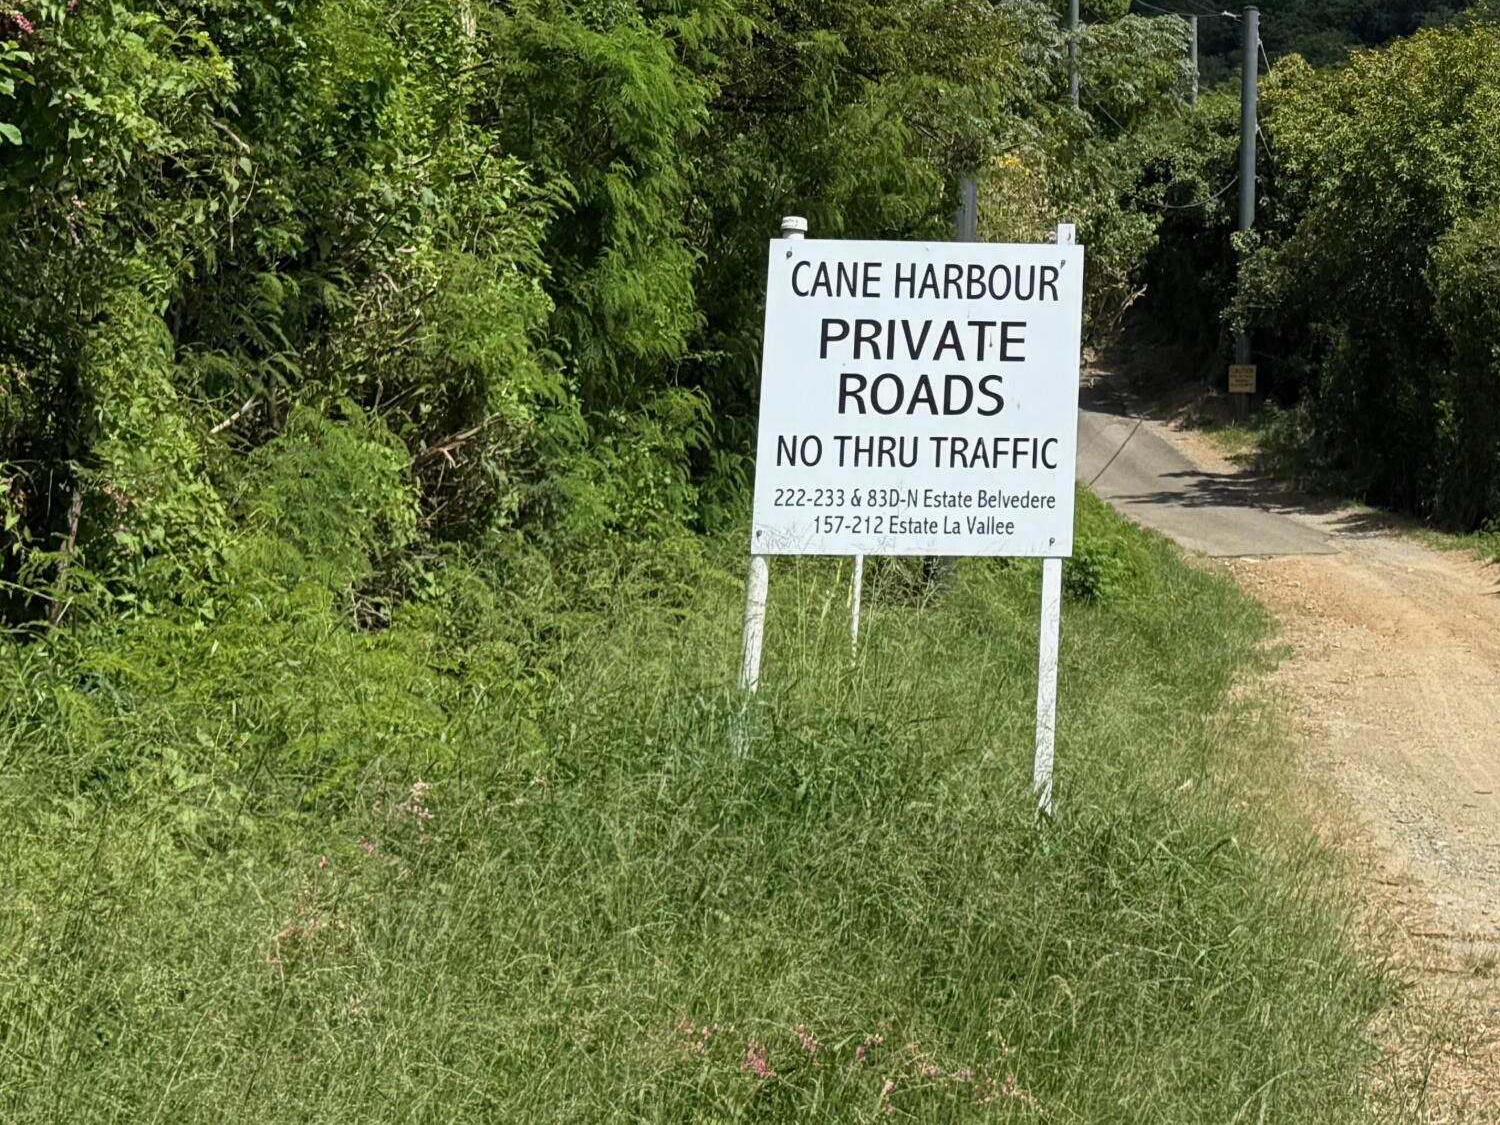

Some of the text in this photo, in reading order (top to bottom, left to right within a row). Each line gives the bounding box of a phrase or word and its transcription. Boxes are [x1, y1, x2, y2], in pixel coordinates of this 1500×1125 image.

[791, 260, 1060, 302] CANE HARBOUR
[819, 318, 1027, 363] PRIVATE
[837, 372, 1005, 417] ROADS
[776, 434, 1059, 470] NO THRU TRAFFIC
[773, 488, 1056, 509] 222-233 & 83D-N Estate Belvedere
[814, 515, 1015, 536] 157-212 Estate La Vallee
